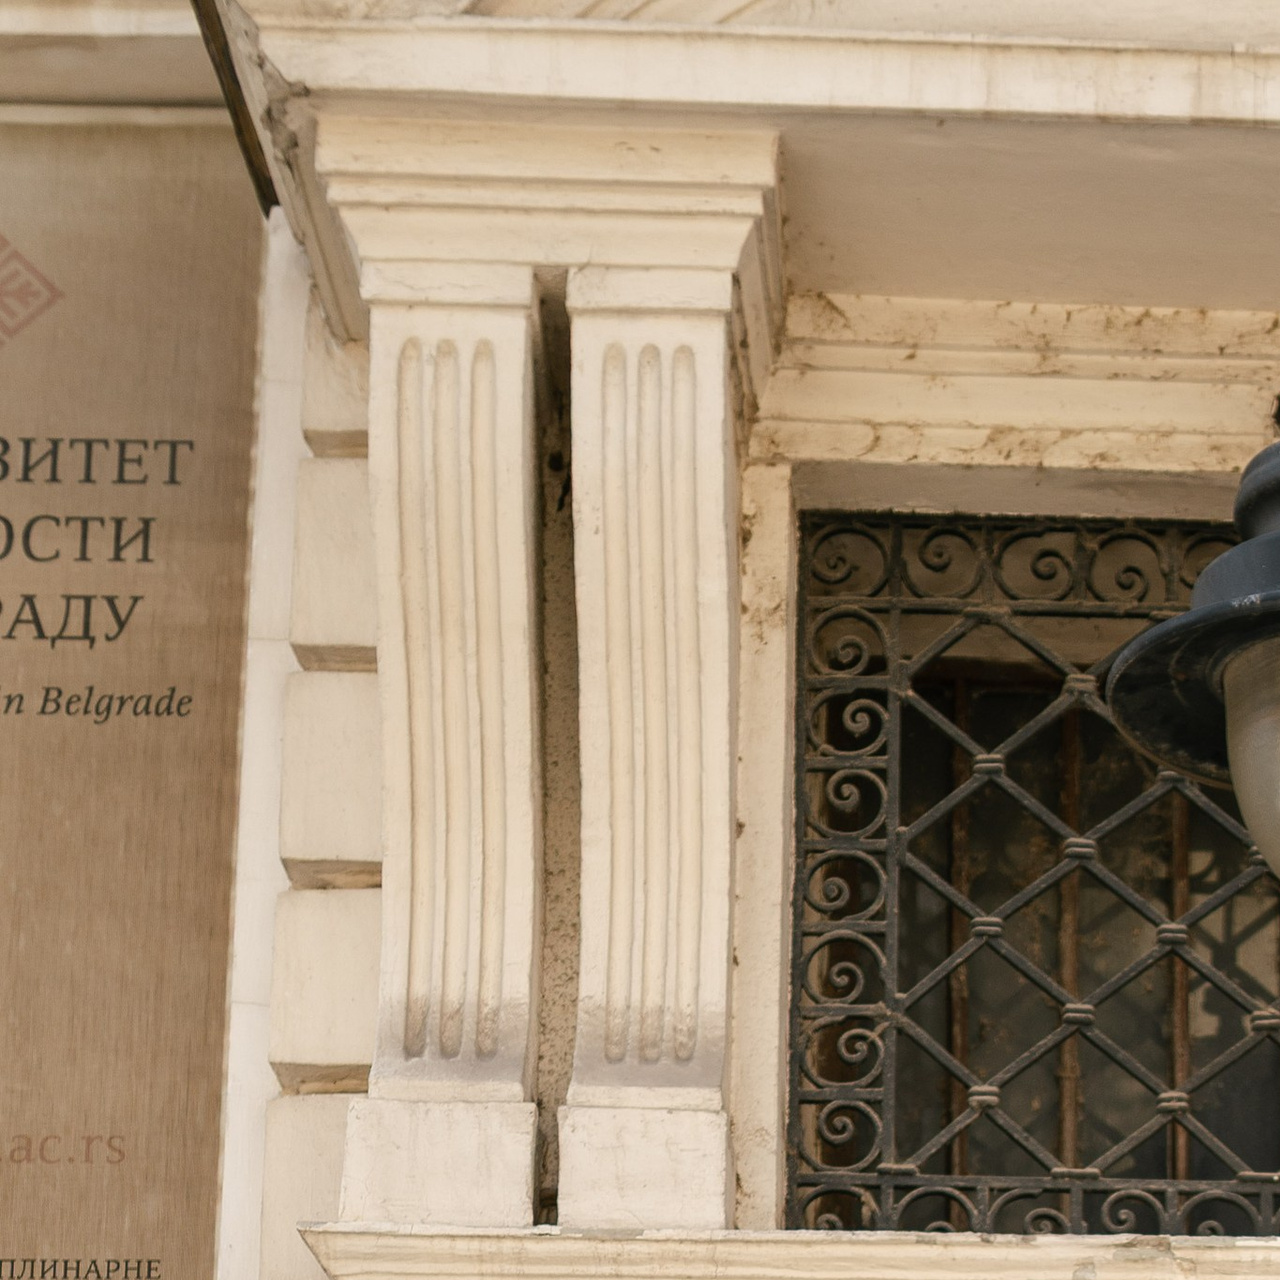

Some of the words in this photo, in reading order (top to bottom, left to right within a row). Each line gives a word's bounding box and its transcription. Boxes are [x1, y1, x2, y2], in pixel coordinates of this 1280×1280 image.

[0, 593, 145, 650] АДУ
[38, 685, 194, 725] Belgrade
[0, 1132, 127, 1165] ac.rs
